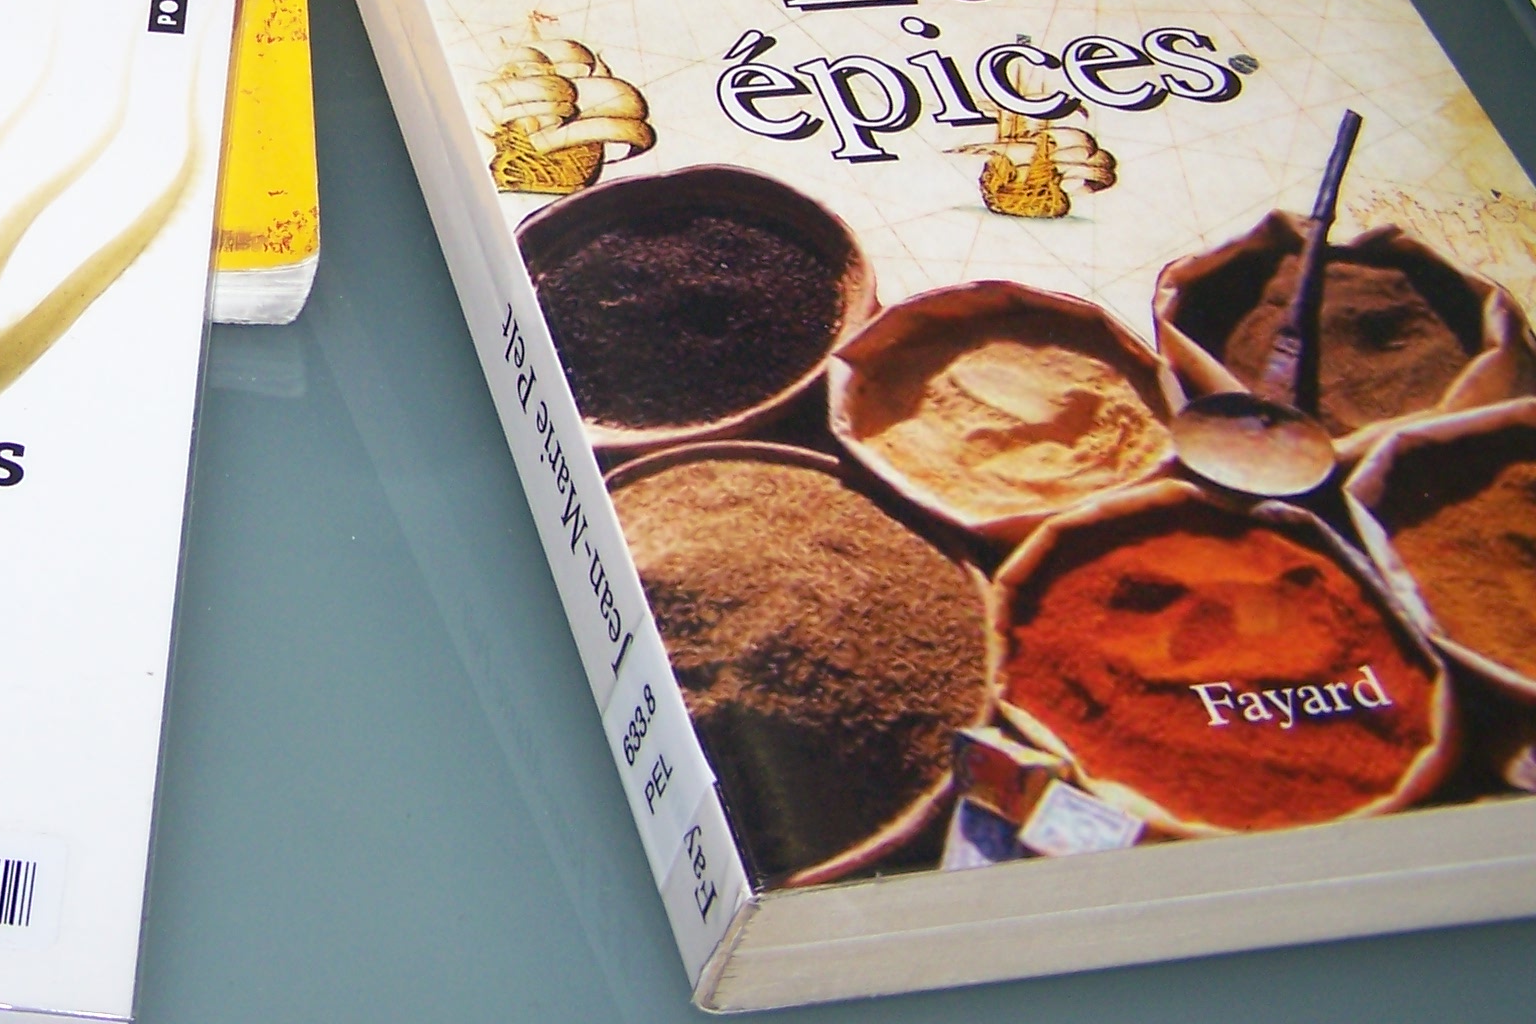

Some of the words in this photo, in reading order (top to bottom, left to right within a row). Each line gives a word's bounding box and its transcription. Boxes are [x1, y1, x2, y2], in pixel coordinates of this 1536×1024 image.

[714, 12, 1246, 163] épices
[501, 302, 537, 414] Pelt
[535, 400, 634, 679] Jean-Marie
[622, 683, 657, 766] 633.8
[1190, 664, 1392, 729] Fayard
[644, 752, 674, 814] PEL
